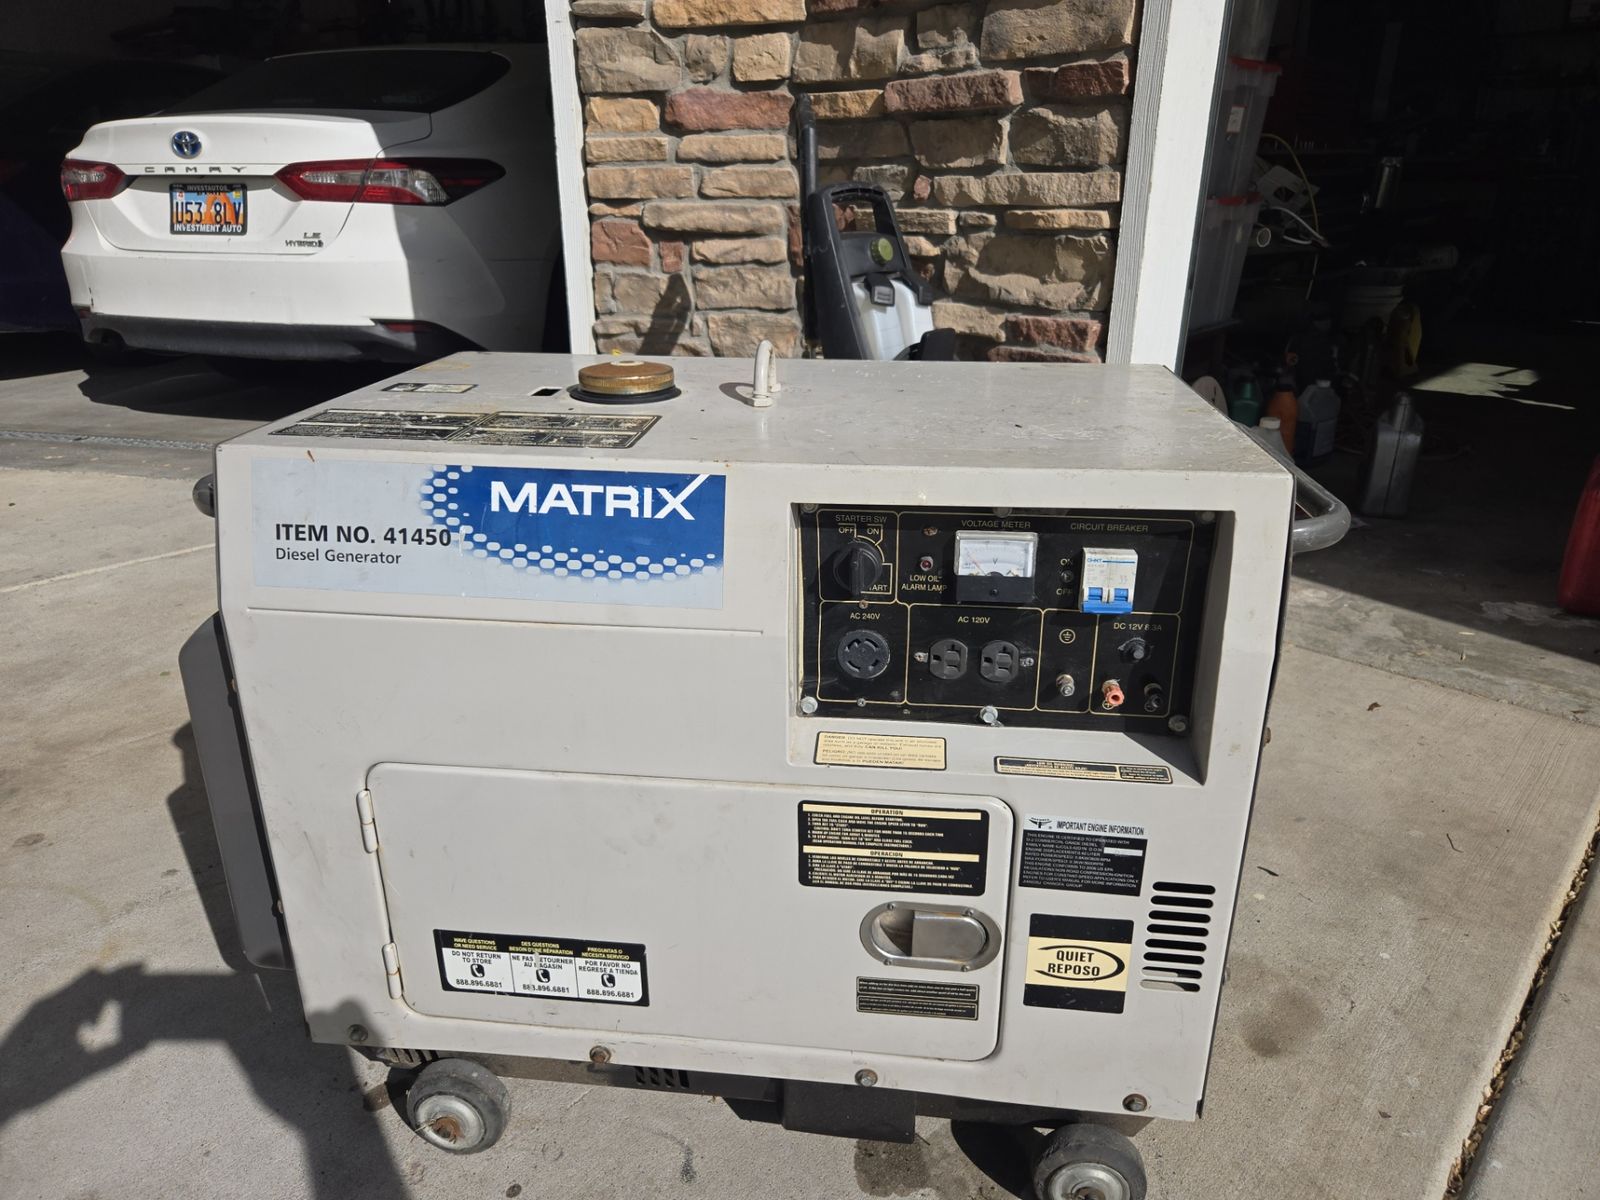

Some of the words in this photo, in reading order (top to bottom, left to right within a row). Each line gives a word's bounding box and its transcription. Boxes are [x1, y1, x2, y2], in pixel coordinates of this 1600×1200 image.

[175, 202, 202, 224] U53
[214, 202, 242, 224] 8LV
[174, 224, 220, 232] INVESTMENT
[285, 240, 317, 248] HYBRID
[490, 475, 709, 520] MATRIX
[835, 514, 872, 522] STARTER
[873, 515, 887, 523] SW
[961, 519, 999, 528] VOLTAGE
[1001, 521, 1031, 529] METER
[1070, 523, 1105, 531] CIRCUIT
[1107, 524, 1149, 532] BREAKER
[838, 526, 855, 534] OFF
[866, 527, 880, 535] ON
[274, 524, 327, 541] ITEM
[336, 526, 376, 543] NO.
[383, 527, 452, 546] 41450
[275, 547, 319, 561] Diesel
[325, 550, 402, 564] Generator
[909, 574, 926, 582] LOW
[901, 583, 927, 591] ALARM
[927, 584, 948, 592] LAMP
[957, 616, 970, 624] AC
[971, 617, 990, 625] 120V
[1113, 622, 1126, 630] DC
[1128, 623, 1143, 631] 12V
[1056, 821, 1087, 831] IMPORTANT
[1087, 823, 1107, 833] ENGINE
[1108, 825, 1144, 835] INFORMATION
[870, 850, 903, 858] OPERACION
[1056, 950, 1094, 962] QUIET
[1048, 963, 1100, 976] REPOSO
[456, 979, 502, 988] 888.896.6881
[586, 988, 635, 998] 888.896.6881
